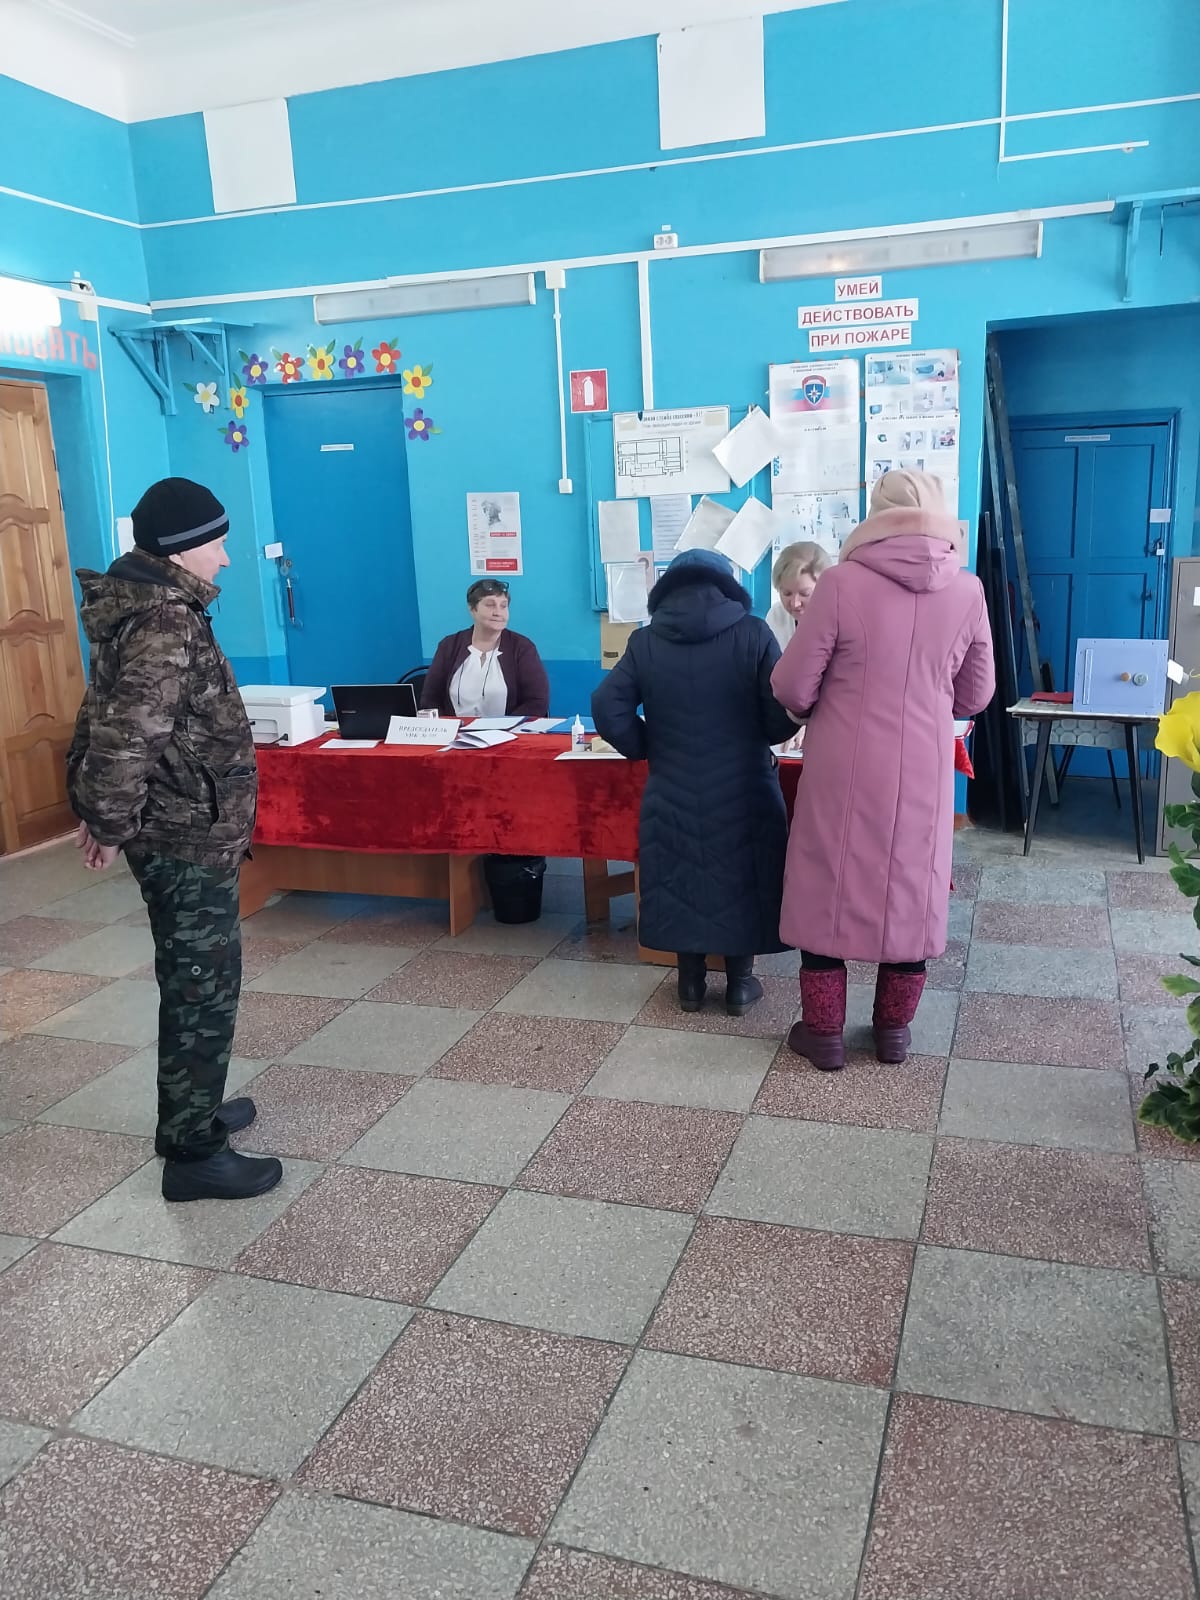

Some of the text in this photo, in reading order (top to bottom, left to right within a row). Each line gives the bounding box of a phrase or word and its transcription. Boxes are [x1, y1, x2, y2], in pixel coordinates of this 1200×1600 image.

[837, 280, 879, 297] УМЕЙ
[802, 305, 914, 325] ДЕЙСТВОВАТЬ
[811, 327, 910, 348] ПРИ ПОЖАРЕ
